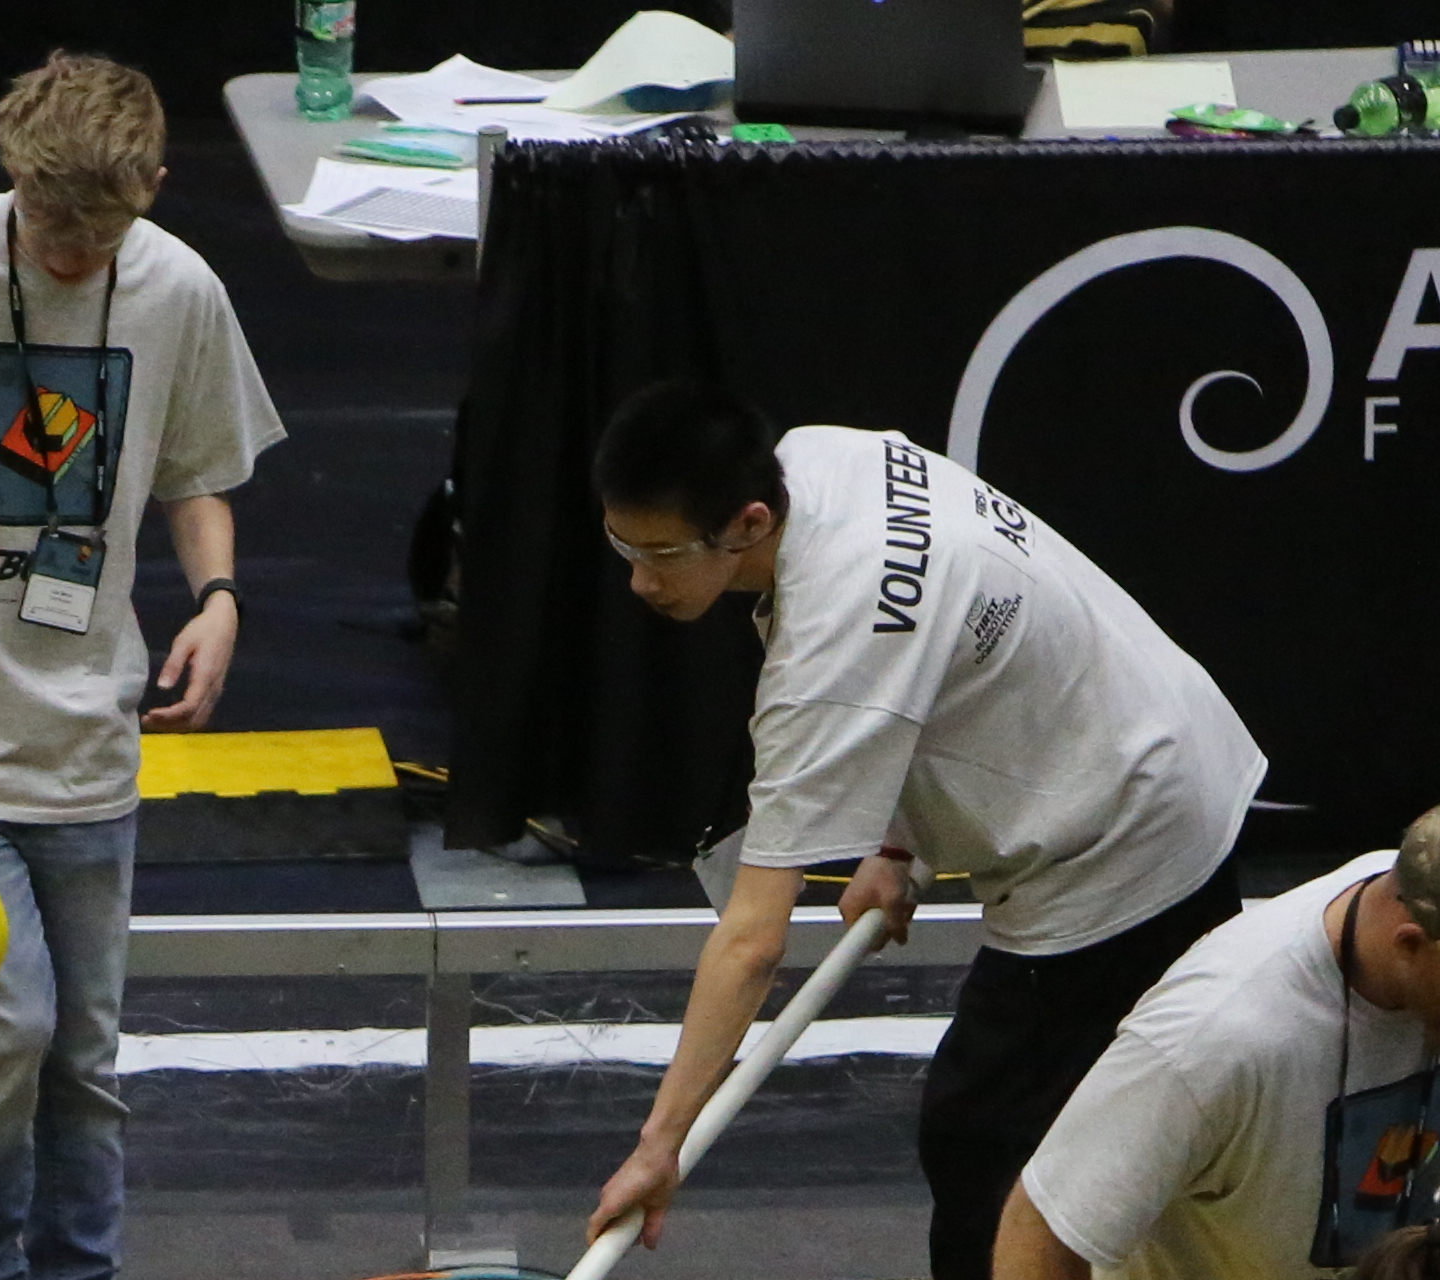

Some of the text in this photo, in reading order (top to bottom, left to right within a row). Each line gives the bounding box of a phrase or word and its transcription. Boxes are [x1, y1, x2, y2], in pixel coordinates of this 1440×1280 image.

[974, 597, 999, 640] FIRST
[975, 597, 1012, 652] ROBOTICS
[975, 593, 1023, 664] COMPETITION
